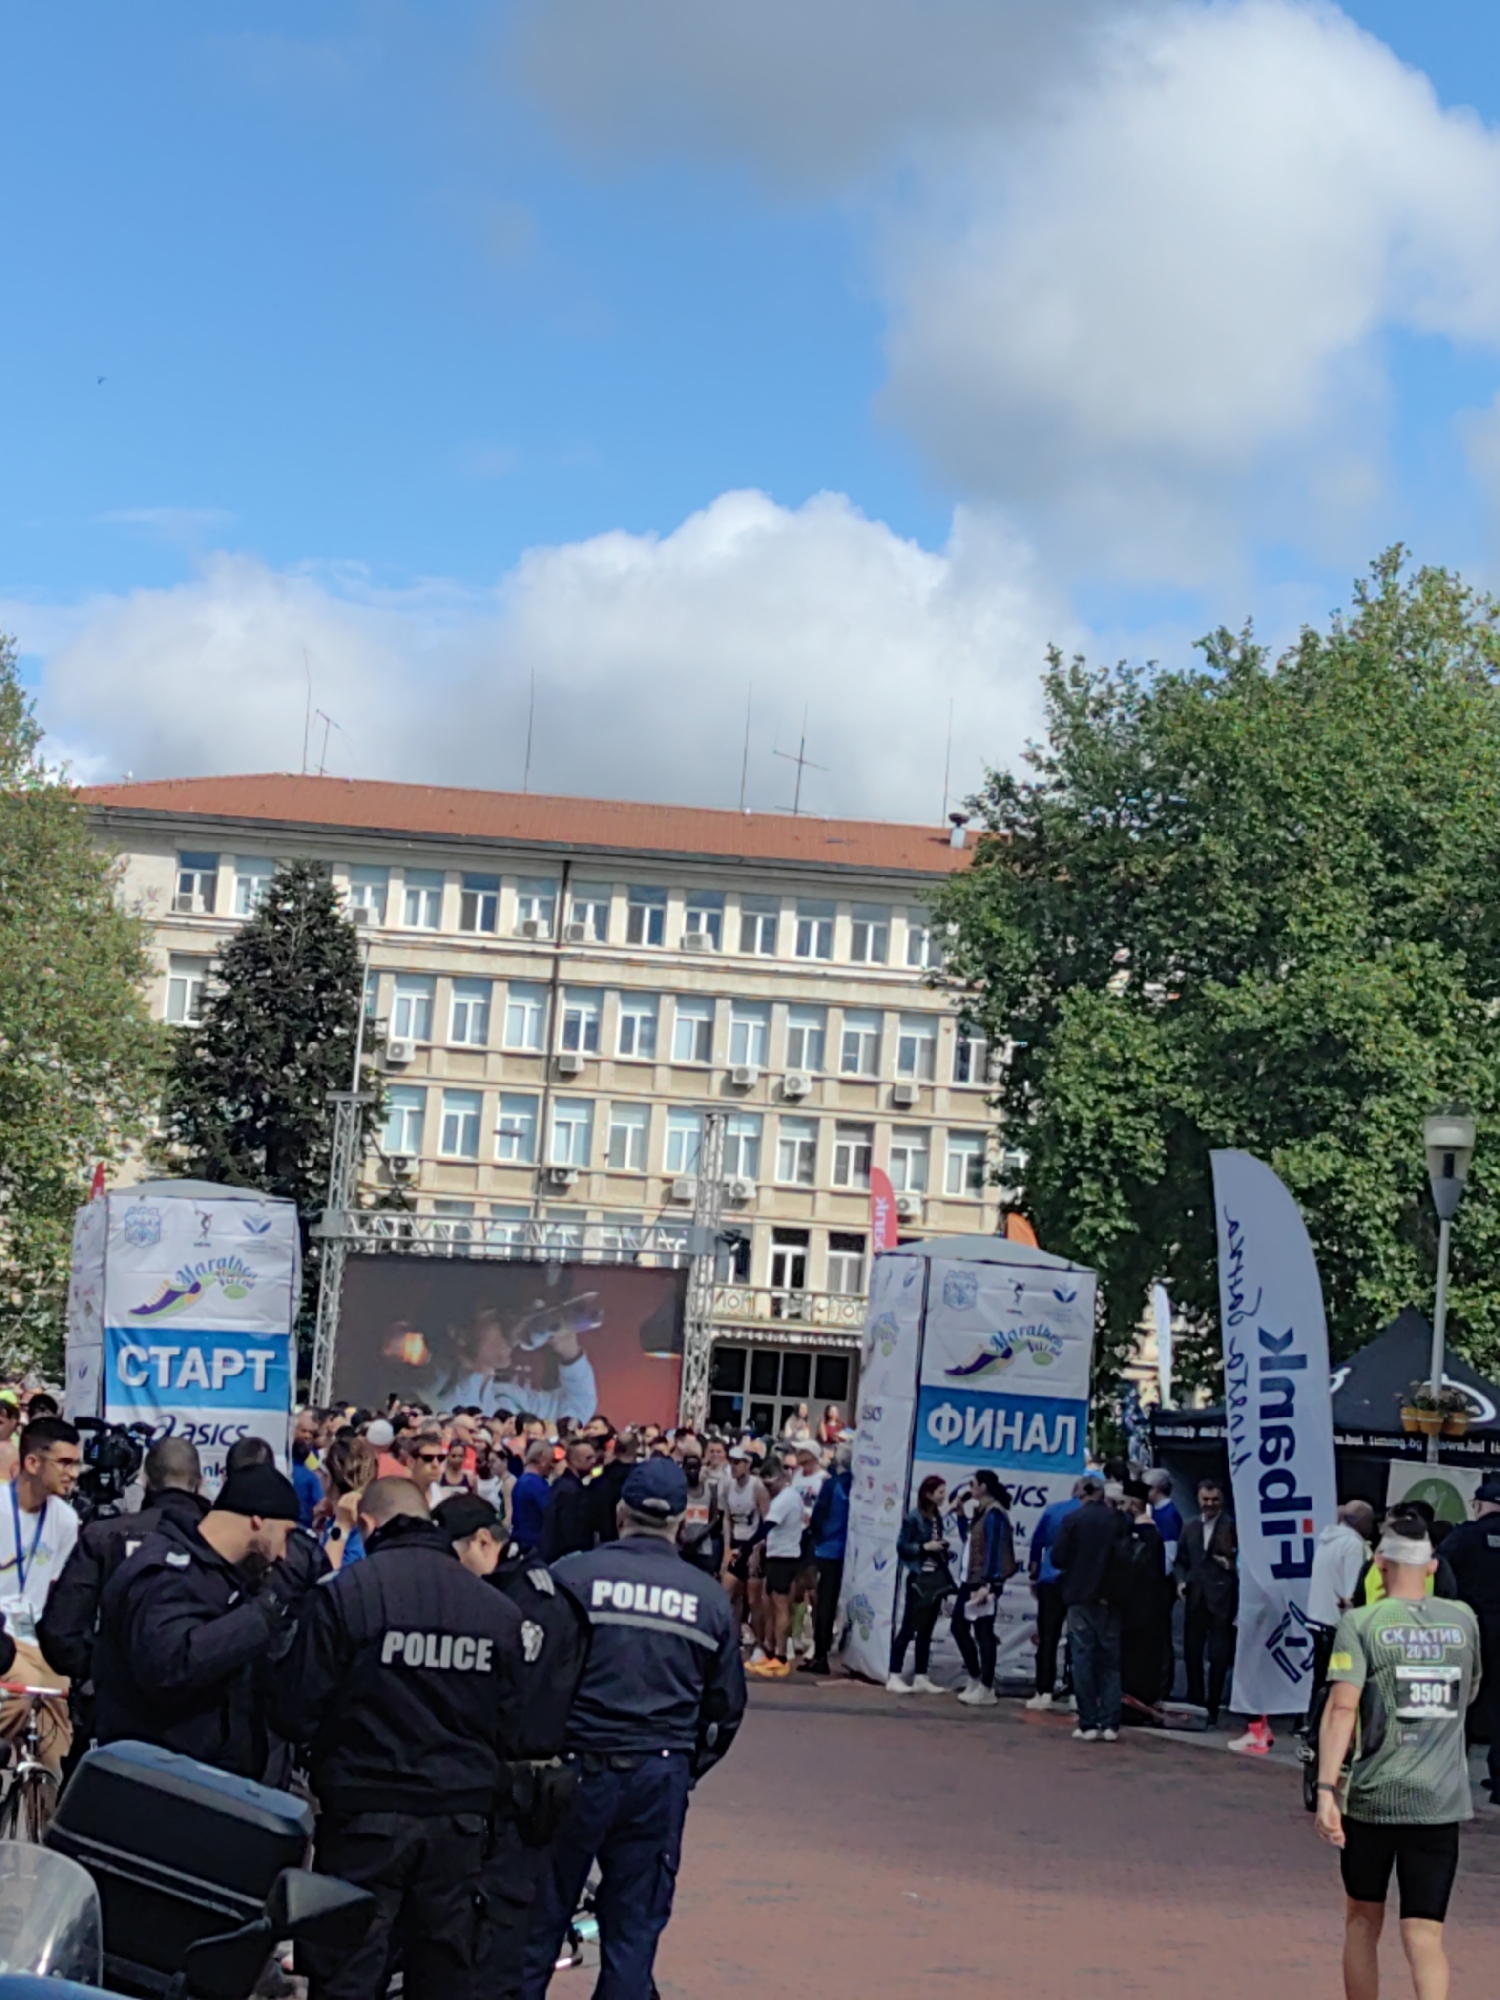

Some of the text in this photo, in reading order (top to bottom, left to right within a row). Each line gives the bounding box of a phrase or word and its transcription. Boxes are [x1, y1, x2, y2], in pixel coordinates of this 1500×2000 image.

[117, 1344, 276, 1392] СТАРТ
[926, 1402, 1077, 1456] ФИНАЛ
[591, 1579, 699, 1622] POLICE
[381, 1630, 494, 1672] POLICE
[1409, 1627, 1462, 1645] АКТИВ
[1409, 1682, 1452, 1704] 3501
